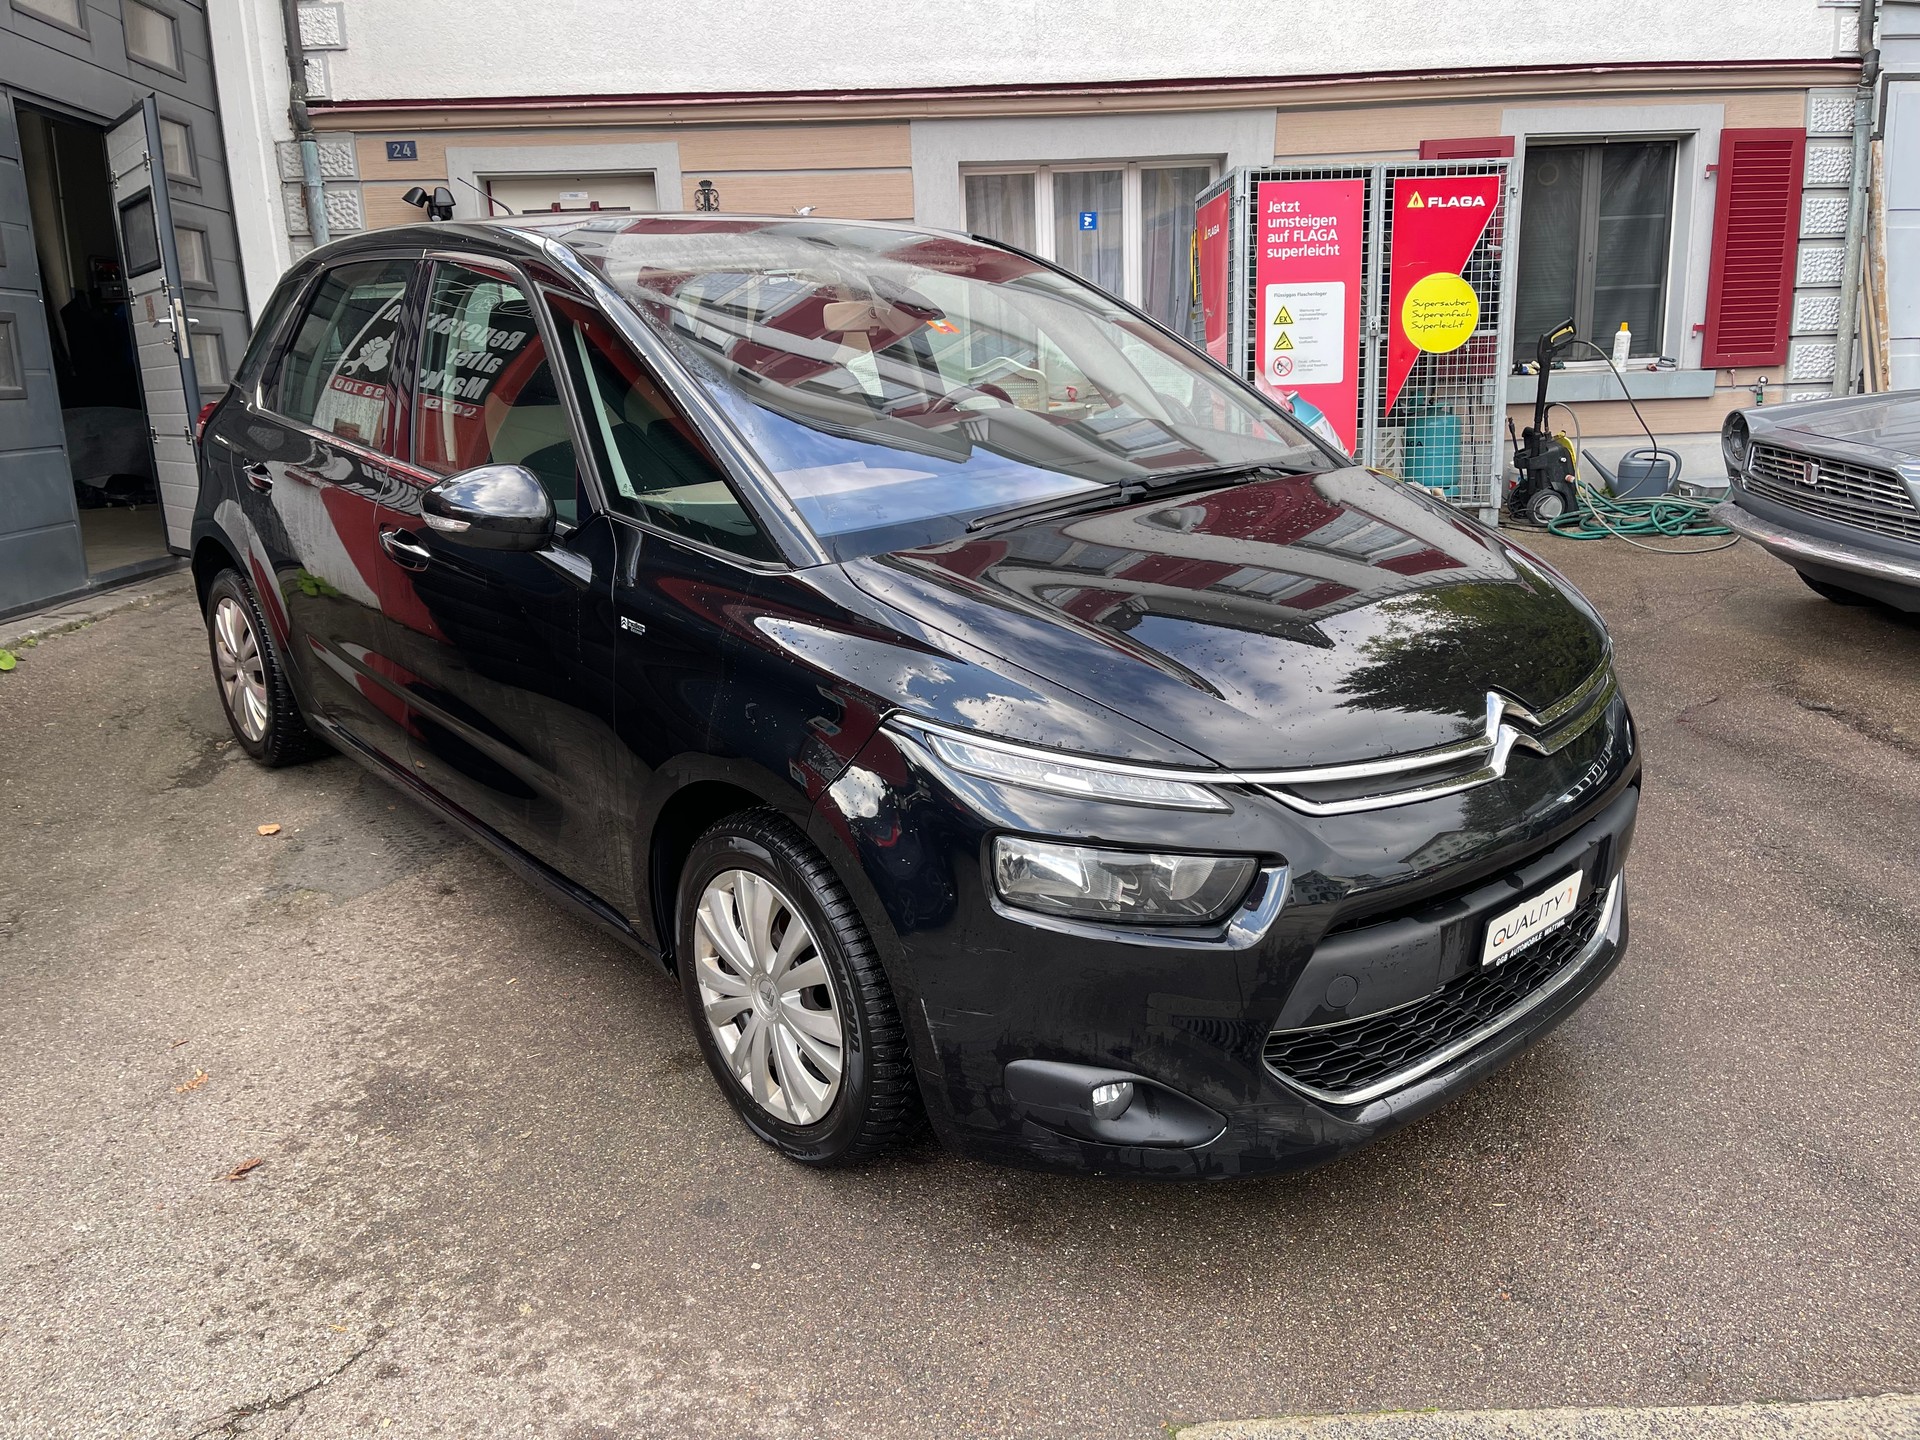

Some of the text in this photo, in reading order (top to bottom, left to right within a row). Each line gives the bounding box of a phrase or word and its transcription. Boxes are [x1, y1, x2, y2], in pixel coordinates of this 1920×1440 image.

[392, 143, 411, 157] 24
[1267, 201, 1300, 213] Jetzt
[1427, 196, 1485, 208] FLAGA
[1267, 214, 1337, 229] umsteigen
[1267, 229, 1338, 243] auf FLAGA
[1267, 243, 1340, 260] superleicht
[1412, 299, 1471, 311] Supersauber
[1411, 309, 1472, 321] Supereinfach
[1411, 320, 1464, 332] Superleicht
